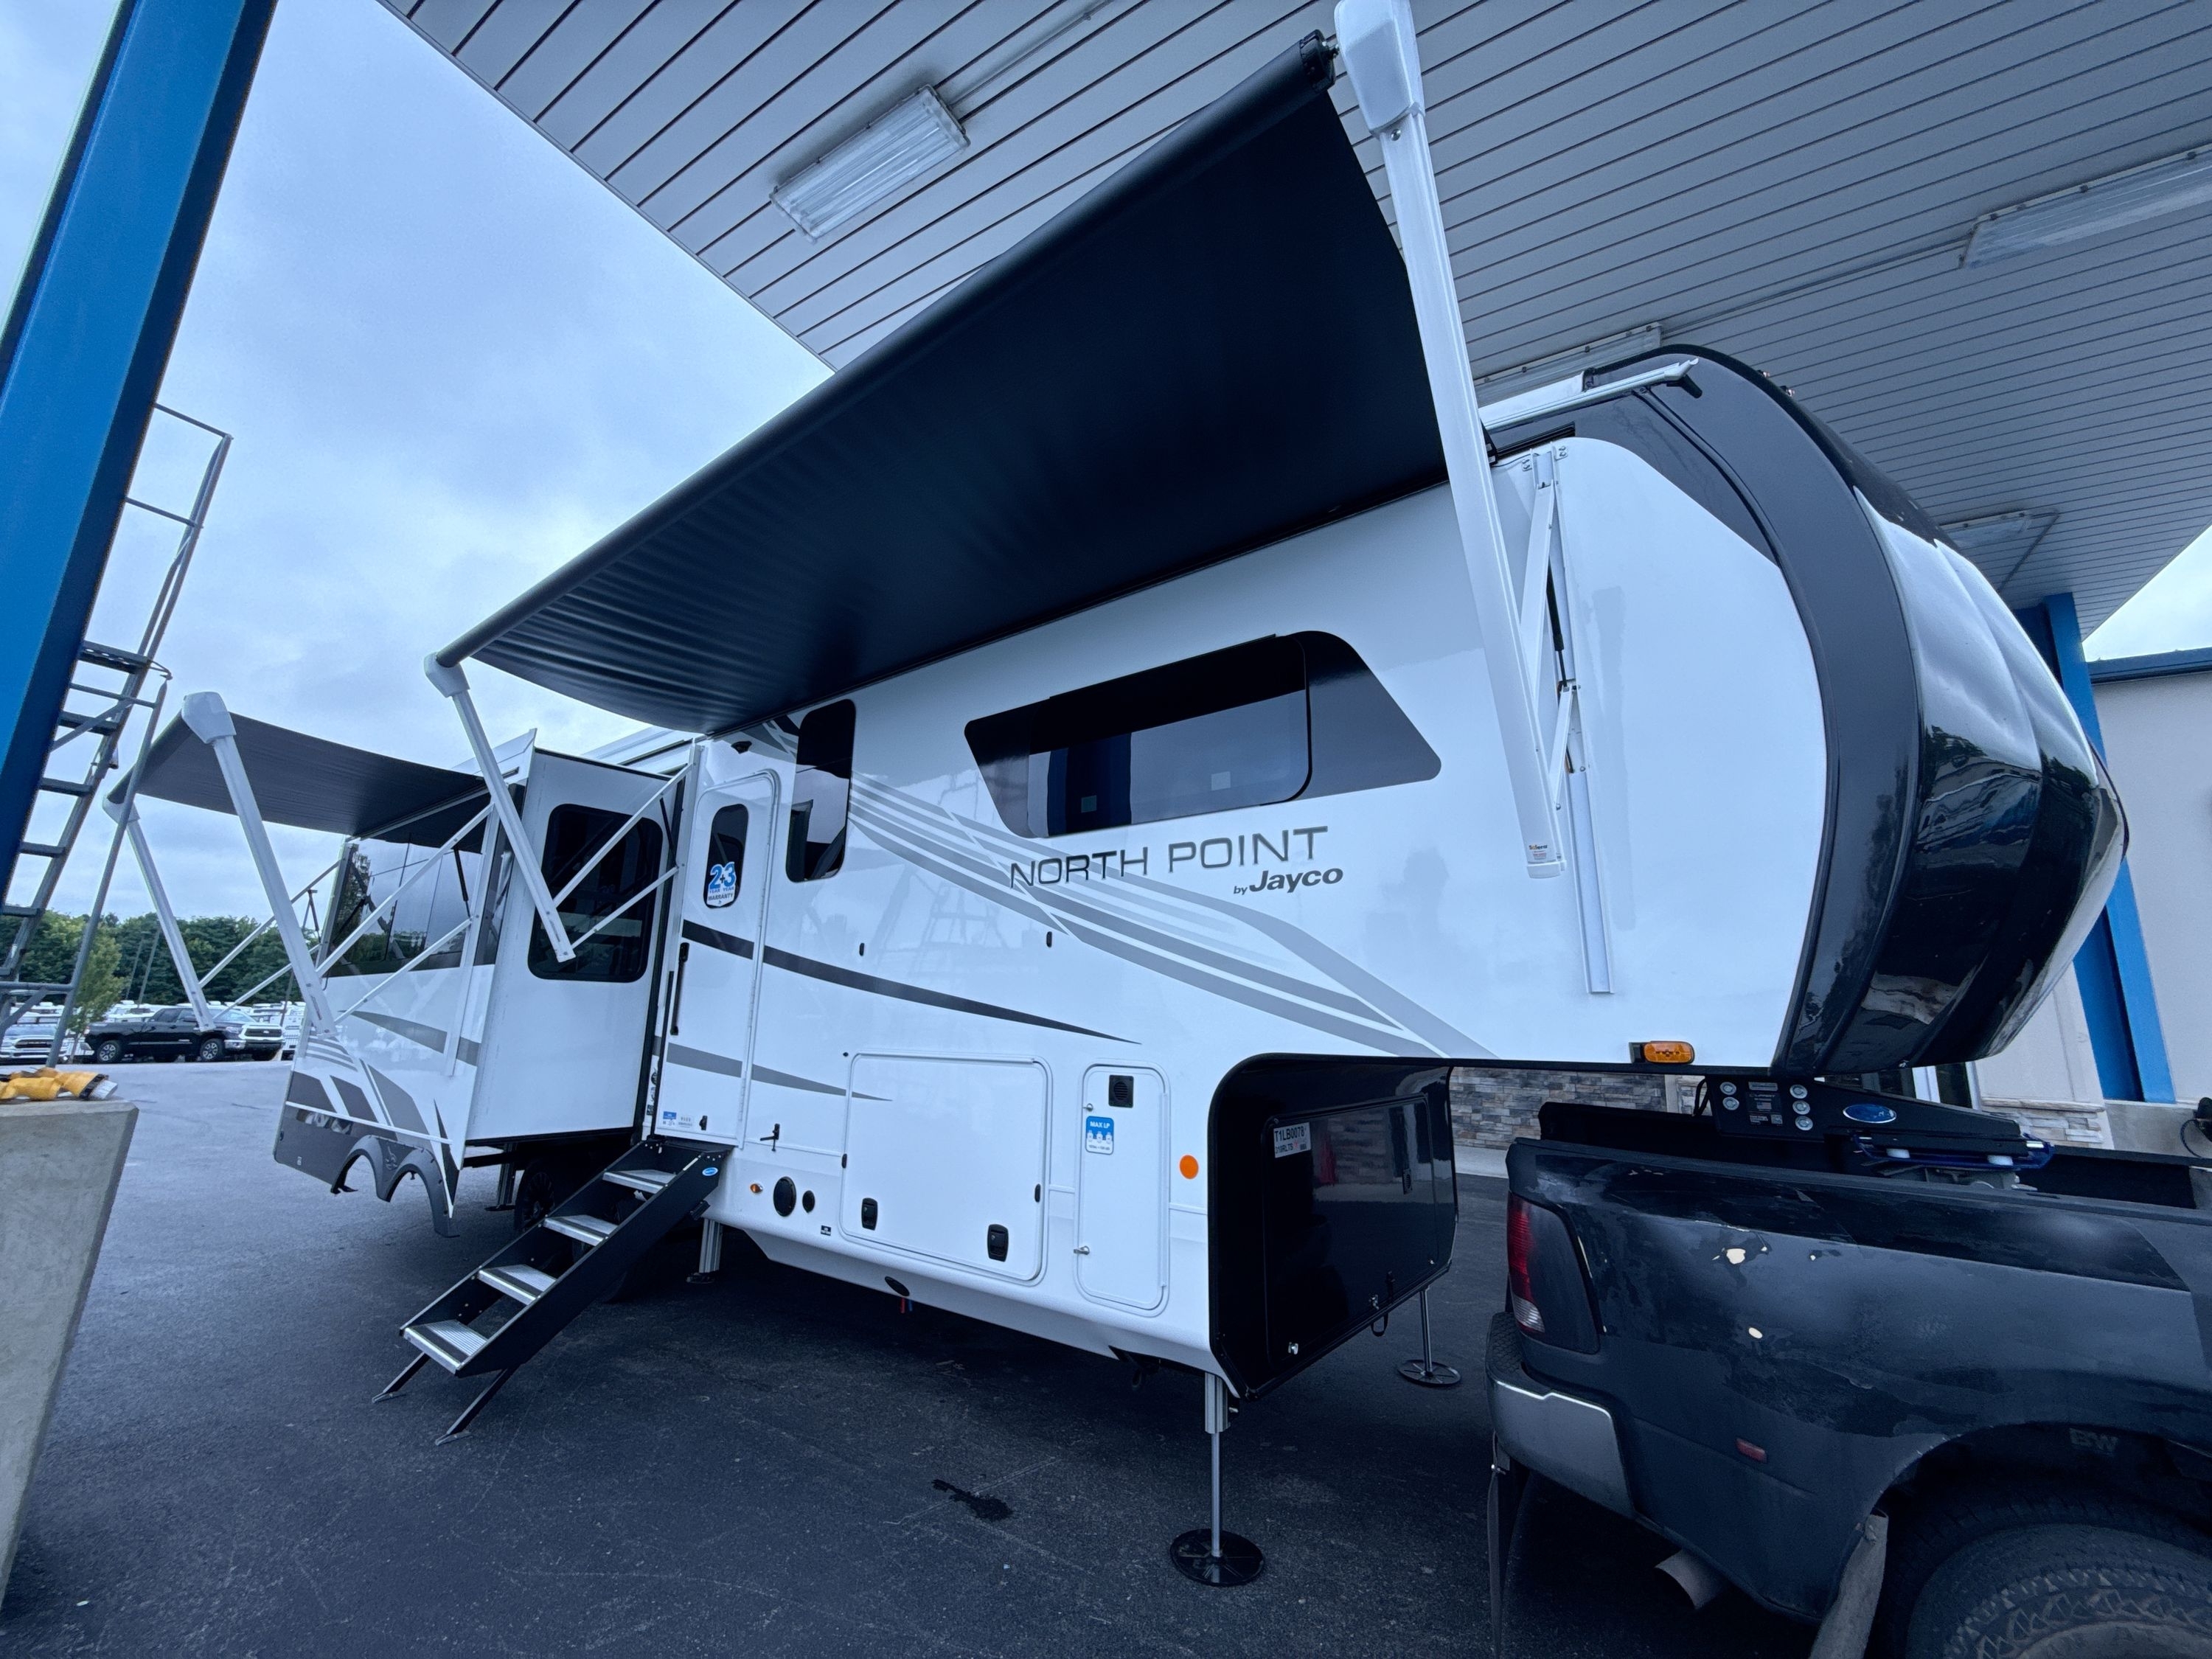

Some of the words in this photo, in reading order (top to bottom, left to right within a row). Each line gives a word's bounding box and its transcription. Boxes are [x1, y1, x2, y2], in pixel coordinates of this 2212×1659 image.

[1010, 846, 1148, 888] NORTH
[1168, 826, 1328, 873] POINT
[1234, 885, 1248, 896] by
[1249, 868, 1343, 894] Jayco
[708, 893, 734, 901] WARRANTY
